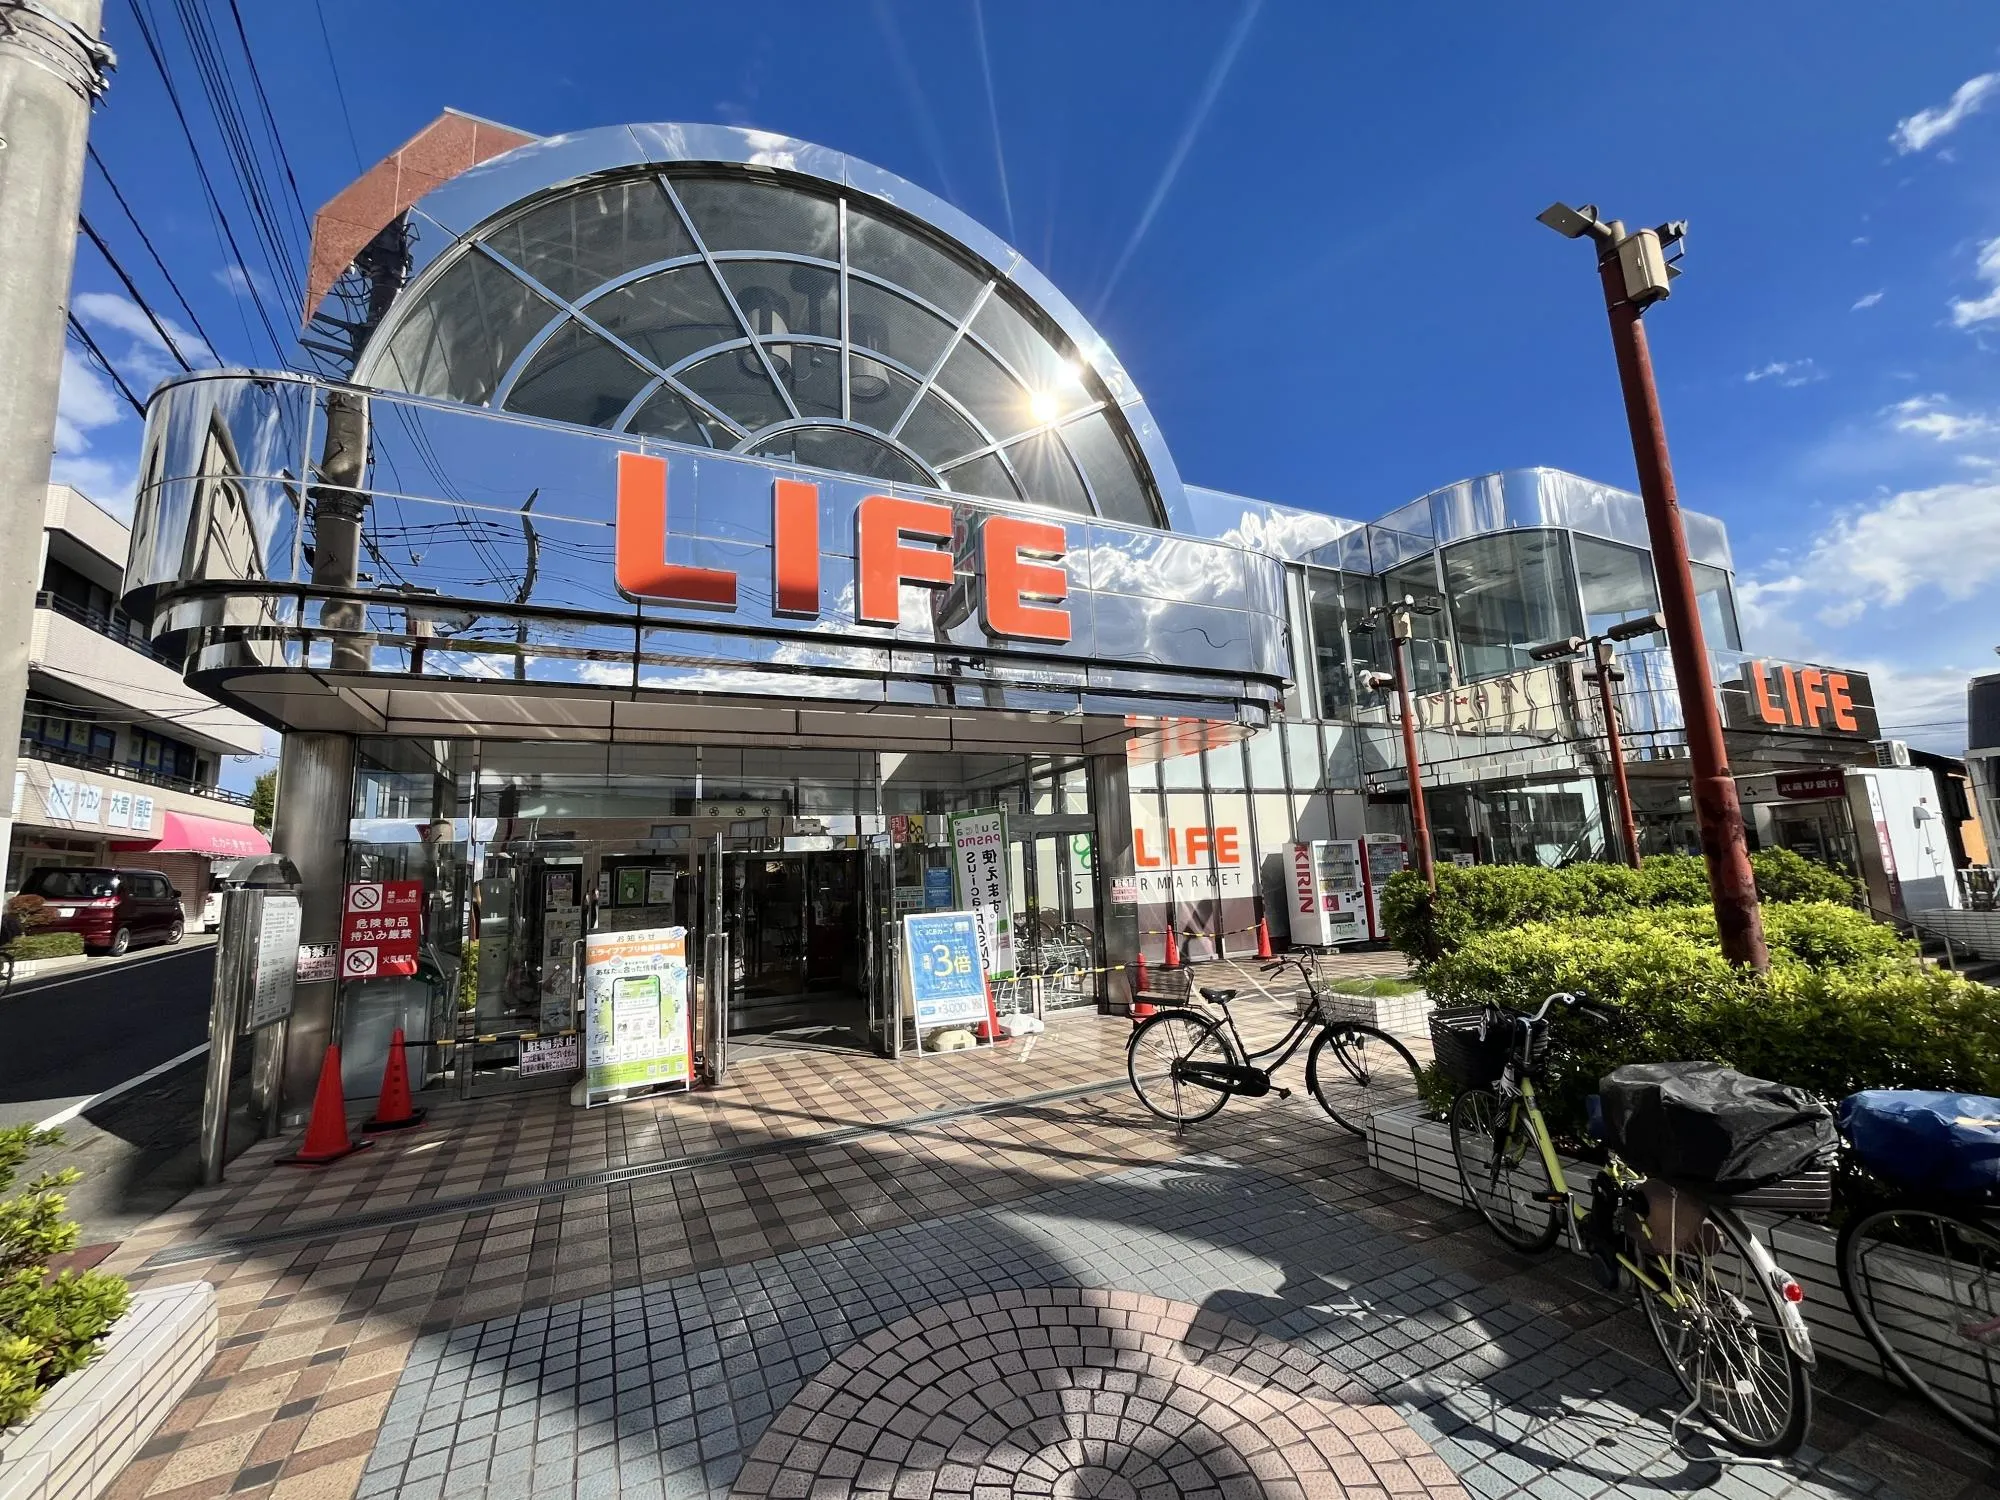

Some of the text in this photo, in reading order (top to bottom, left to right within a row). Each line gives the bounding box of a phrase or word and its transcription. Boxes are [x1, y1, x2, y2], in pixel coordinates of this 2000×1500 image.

[614, 450, 1072, 645] LIFE
[1748, 659, 1858, 731] LIFE
[1134, 827, 1240, 867] LIFE
[1294, 842, 1315, 914] KIRIN
[350, 929, 412, 942] 持込み厳禁
[356, 916, 409, 929] 危険物品
[616, 933, 655, 942] お知らせ
